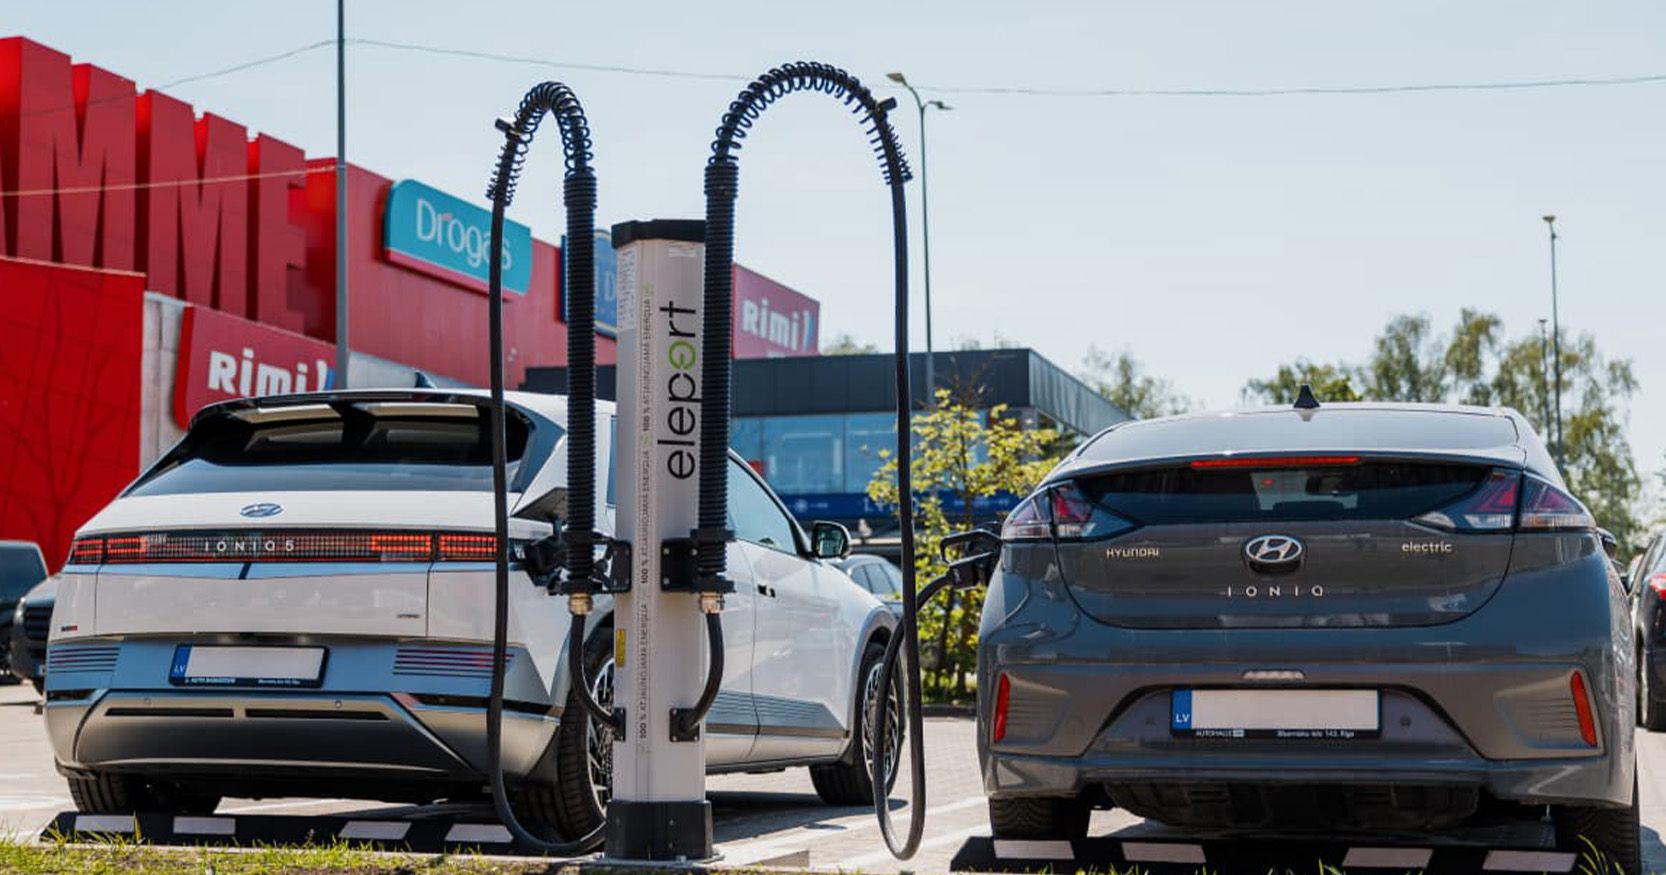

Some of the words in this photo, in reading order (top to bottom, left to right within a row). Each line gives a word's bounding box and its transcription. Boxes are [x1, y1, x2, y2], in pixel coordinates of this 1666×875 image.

[0, 36, 306, 336] MME
[742, 297, 800, 352] Rimi
[207, 346, 309, 398] Rimi
[204, 541, 276, 552] IONIQ
[285, 540, 295, 552] 5
[1106, 547, 1159, 559] HYUNDAI
[1401, 541, 1452, 552] electric
[640, 568, 649, 584] 100
[1227, 584, 1324, 597] IONIQ
[1175, 713, 1190, 723] LV
[639, 723, 647, 739] 100
